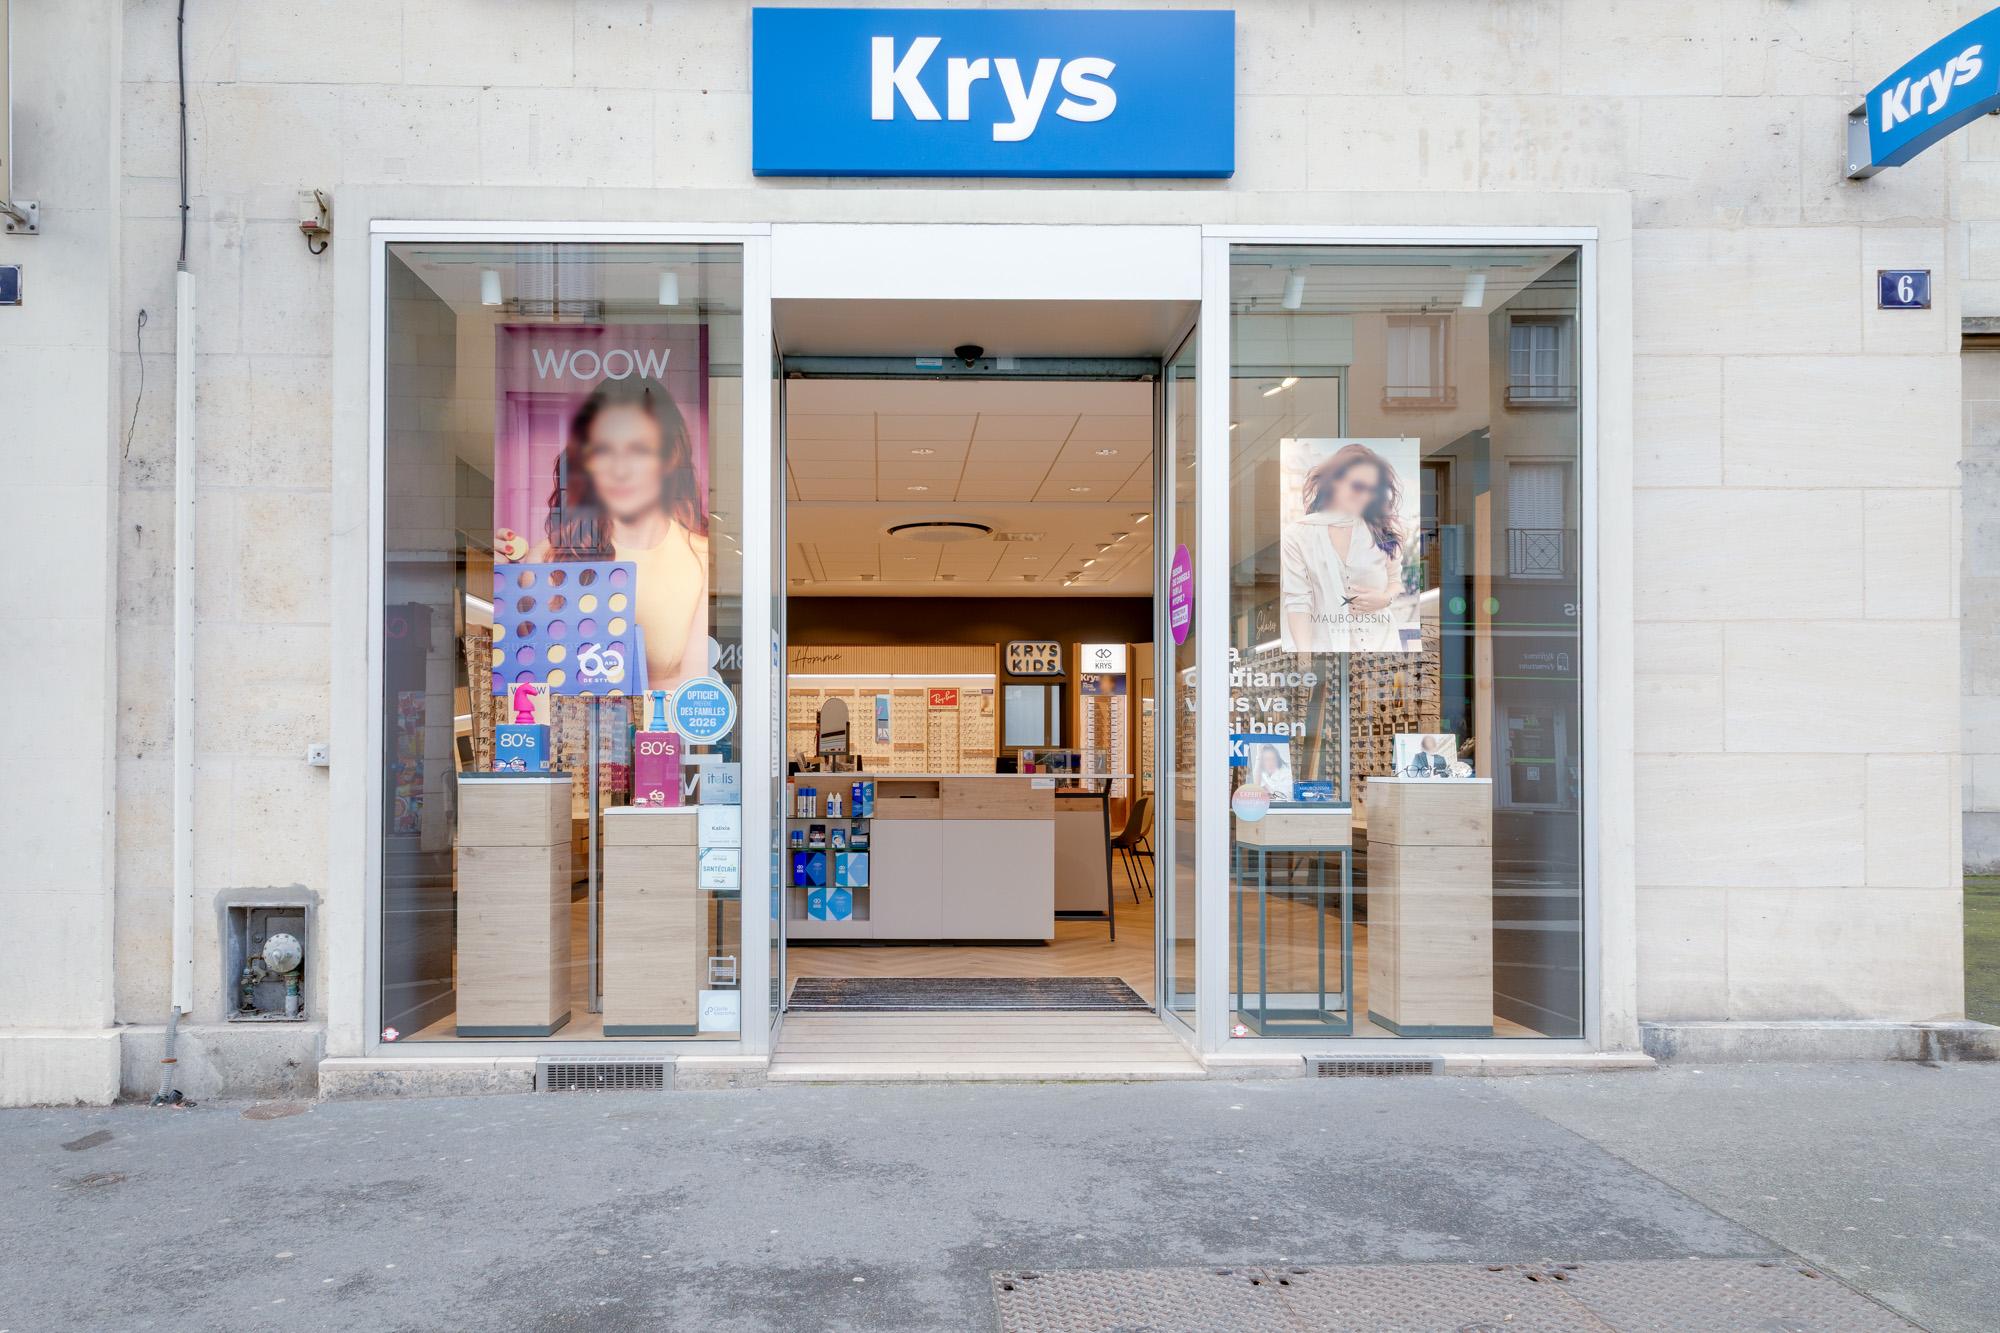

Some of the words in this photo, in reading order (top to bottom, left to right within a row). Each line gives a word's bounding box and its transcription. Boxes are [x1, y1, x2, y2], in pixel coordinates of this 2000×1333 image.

[871, 36, 1117, 142] Krys
[1881, 44, 1983, 133] Krys
[1897, 275, 1914, 303] 6
[532, 349, 671, 380] WOOW
[1310, 613, 1391, 624] MAUBOUSSIN
[792, 641, 842, 670] Homme
[1010, 645, 1058, 658] KRYS
[1012, 659, 1057, 672] KIDS
[687, 690, 719, 700] OPTICIEN
[680, 707, 693, 716] DES
[694, 707, 726, 716] FAMILLES
[1257, 697, 1288, 712] va
[689, 718, 717, 727] 2026
[1249, 717, 1307, 736] bien
[500, 733, 536, 748] 80's
[640, 741, 675, 756] 80's
